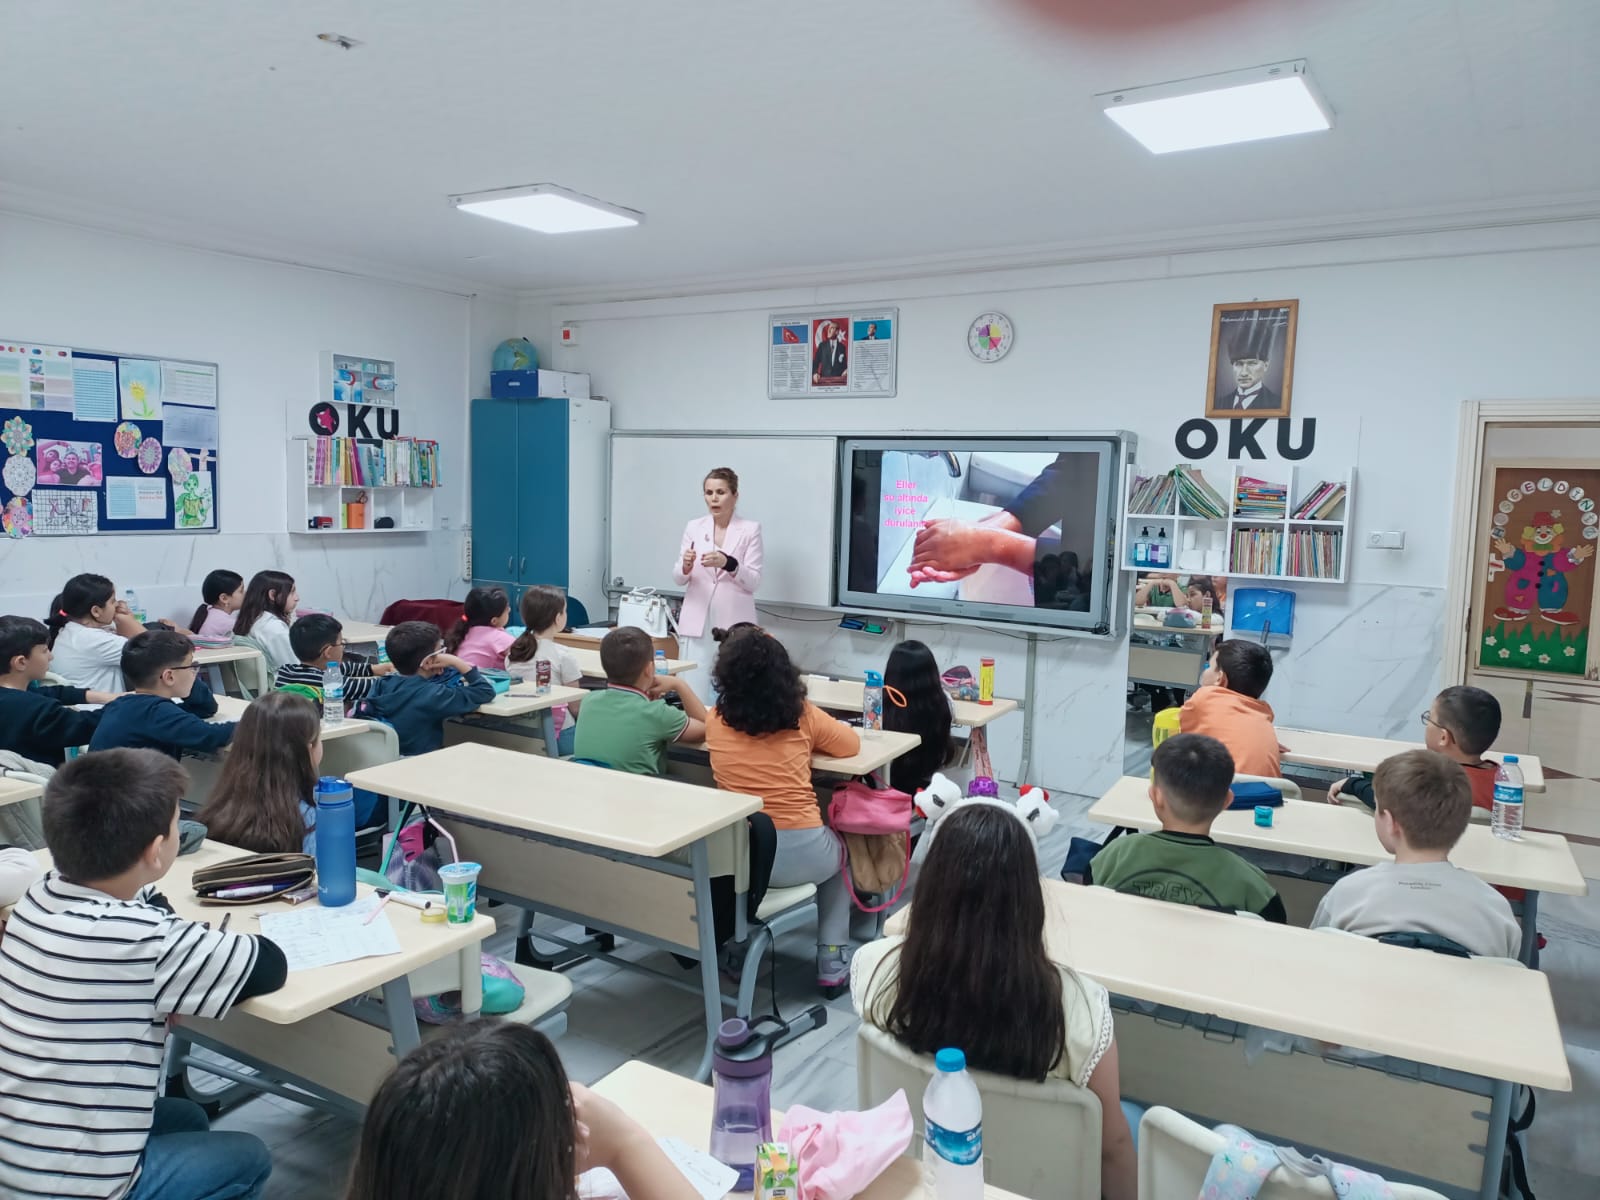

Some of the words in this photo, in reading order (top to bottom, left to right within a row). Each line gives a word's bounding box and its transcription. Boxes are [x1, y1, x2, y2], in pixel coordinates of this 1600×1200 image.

[309, 402, 399, 440] OKU
[1174, 417, 1317, 461] OKU
[896, 480, 916, 489] Eller
